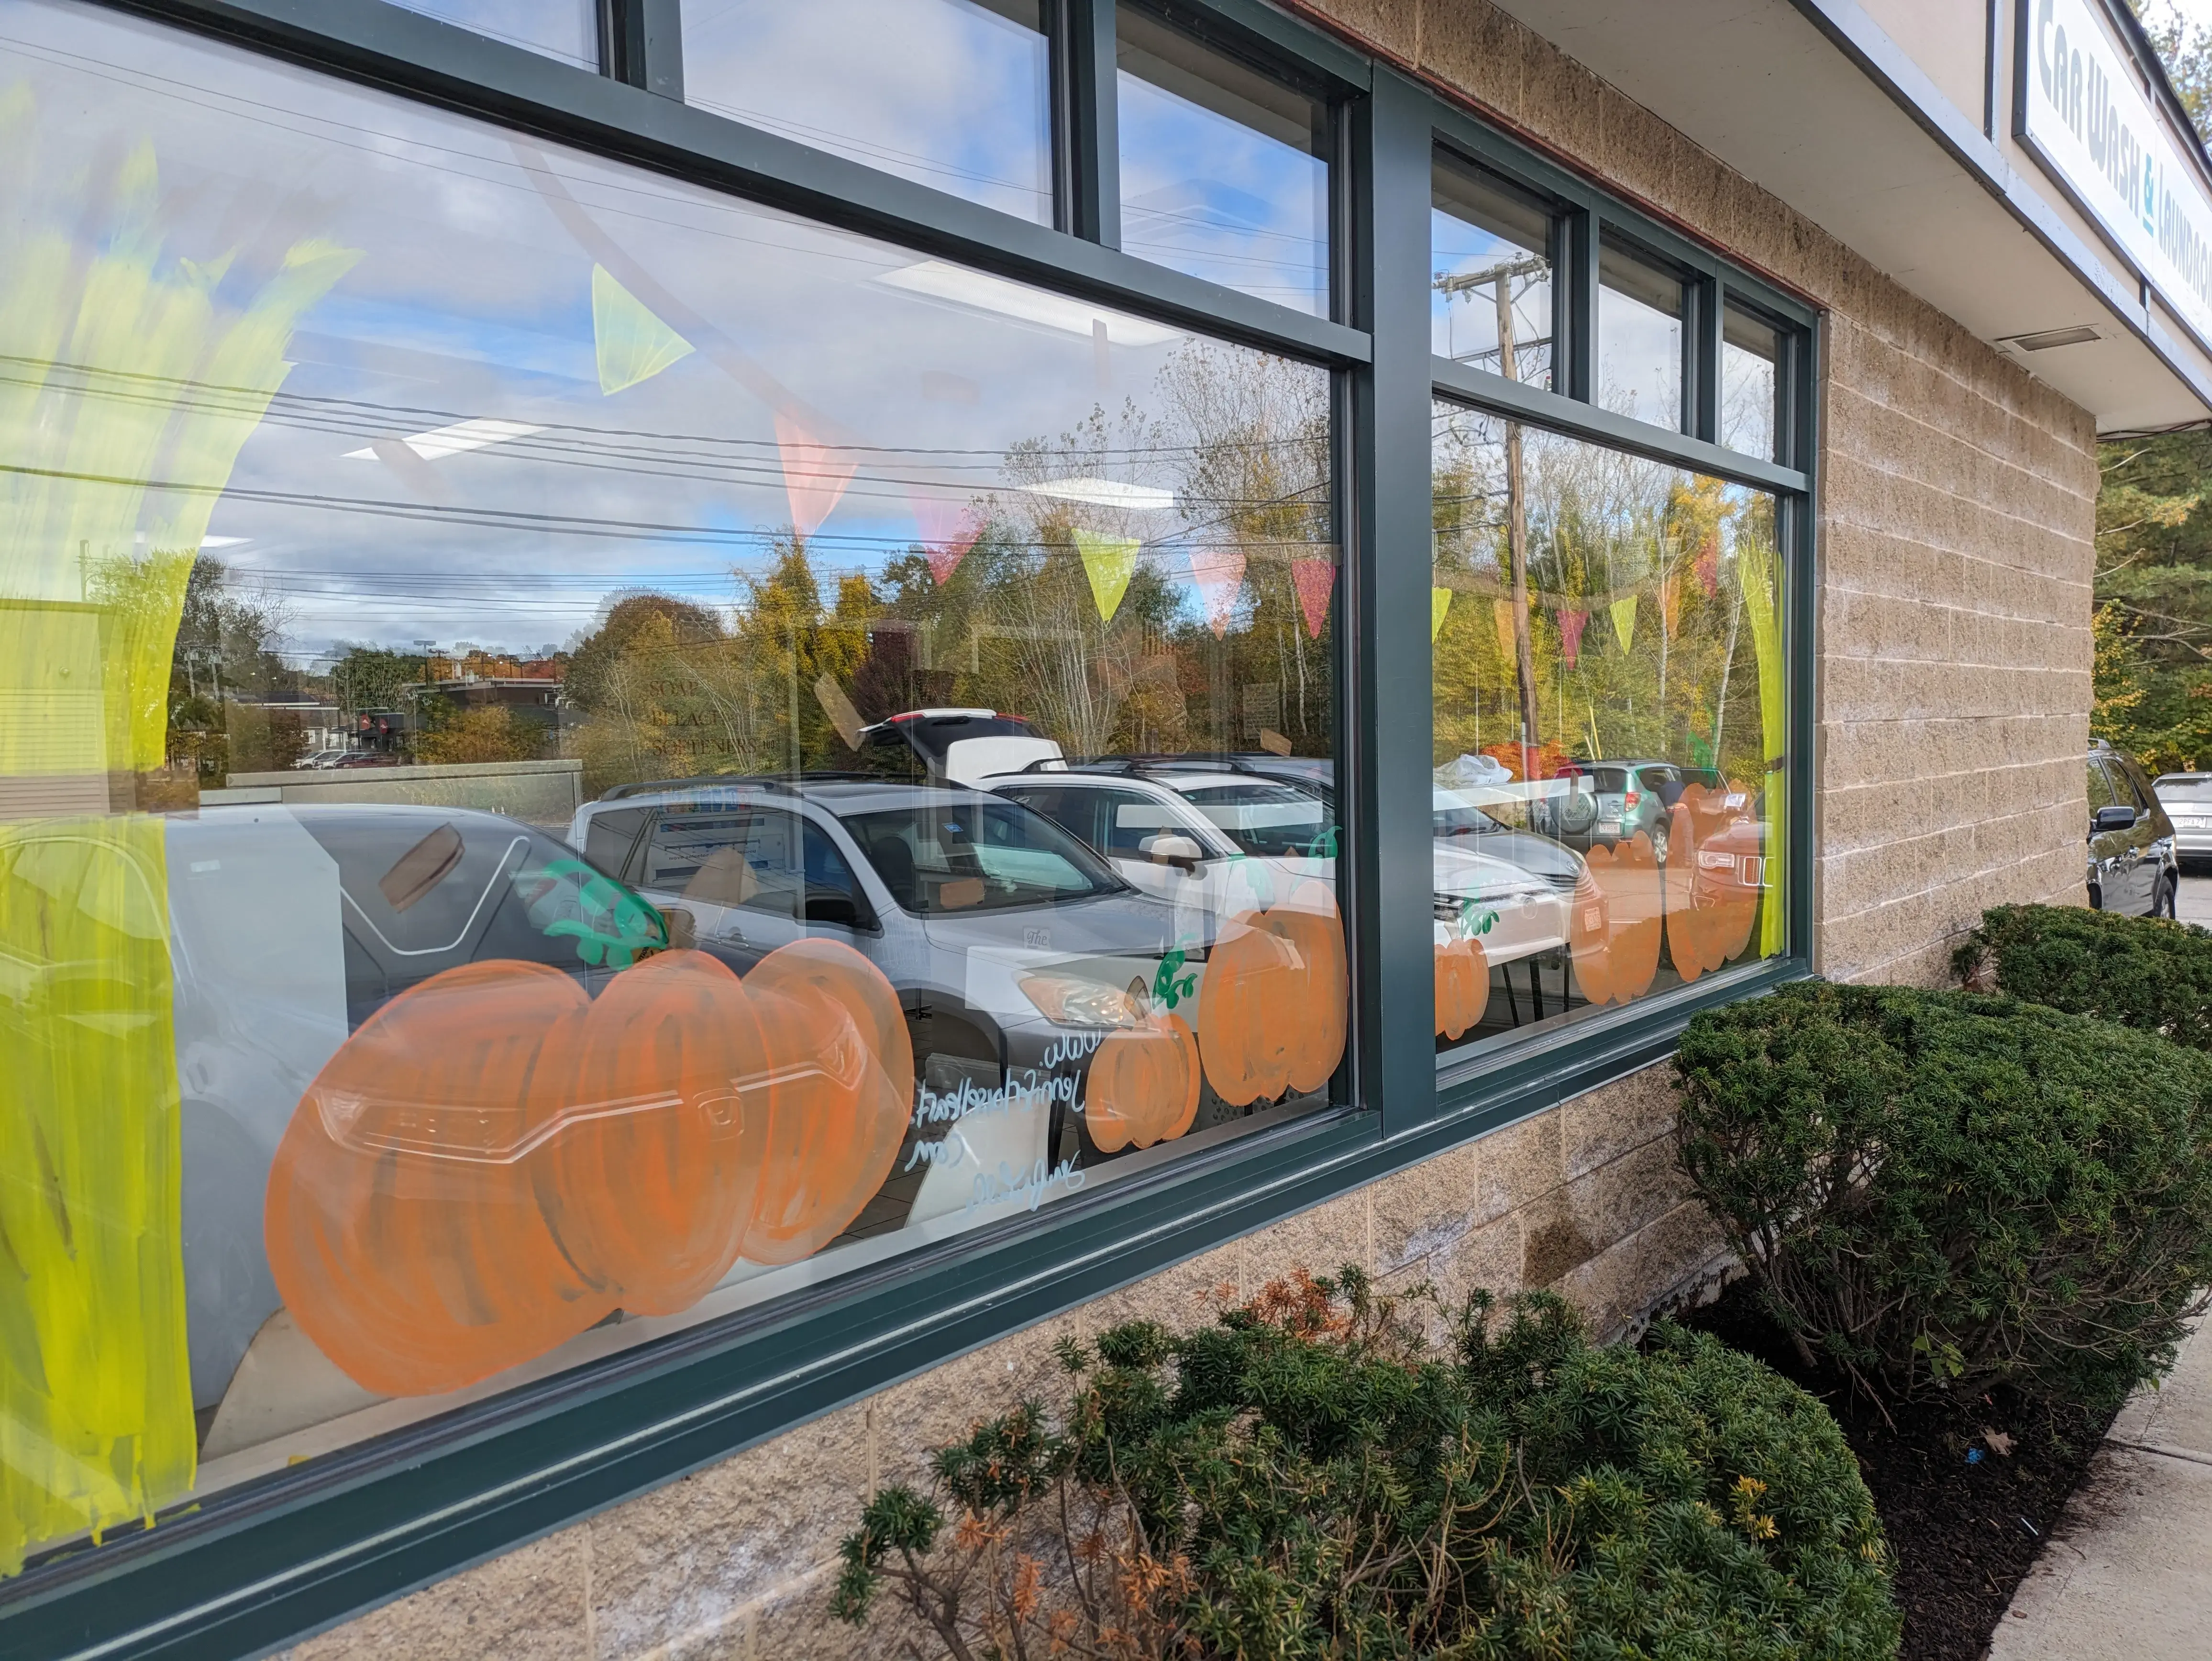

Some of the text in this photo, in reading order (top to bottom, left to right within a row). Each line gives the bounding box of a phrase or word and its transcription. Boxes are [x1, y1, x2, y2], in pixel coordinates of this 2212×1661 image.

[2087, 51, 2140, 219] WASH
[2143, 153, 2154, 238] &
[1027, 930, 1048, 946] The
